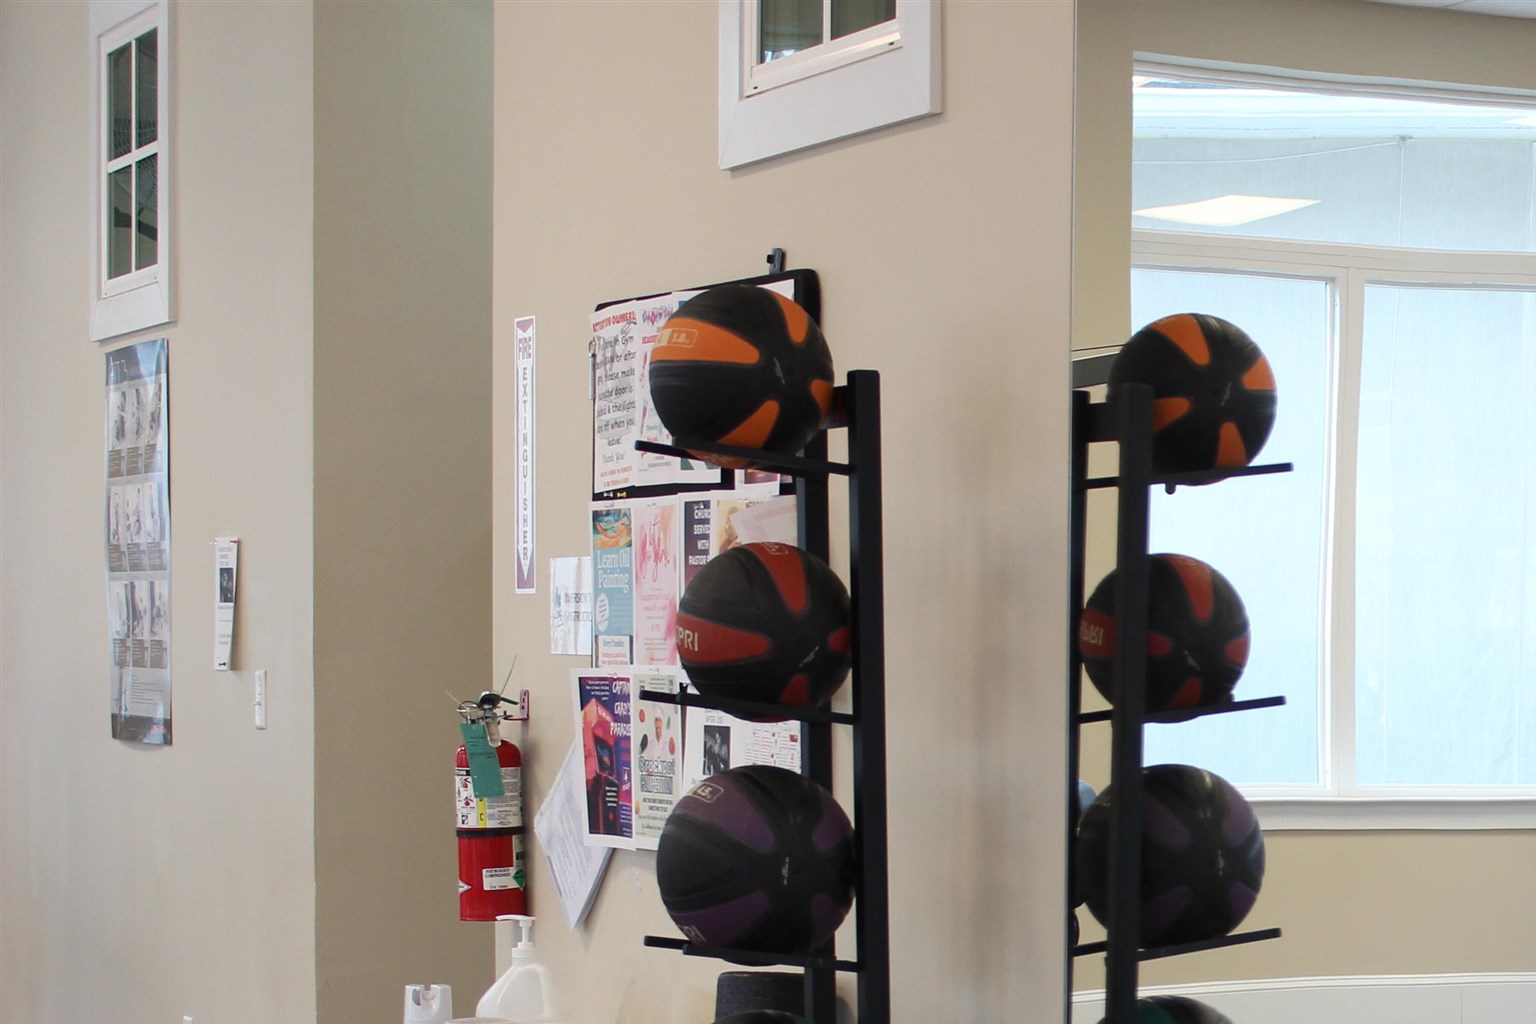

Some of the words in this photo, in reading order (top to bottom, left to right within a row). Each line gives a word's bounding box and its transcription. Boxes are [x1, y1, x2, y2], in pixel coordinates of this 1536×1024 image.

[518, 336, 531, 360] FIRE
[597, 550, 619, 568] Learn
[620, 548, 630, 568] Oil
[597, 568, 629, 594] Painting
[676, 625, 698, 651] PRI
[639, 756, 675, 775] Crockpot
